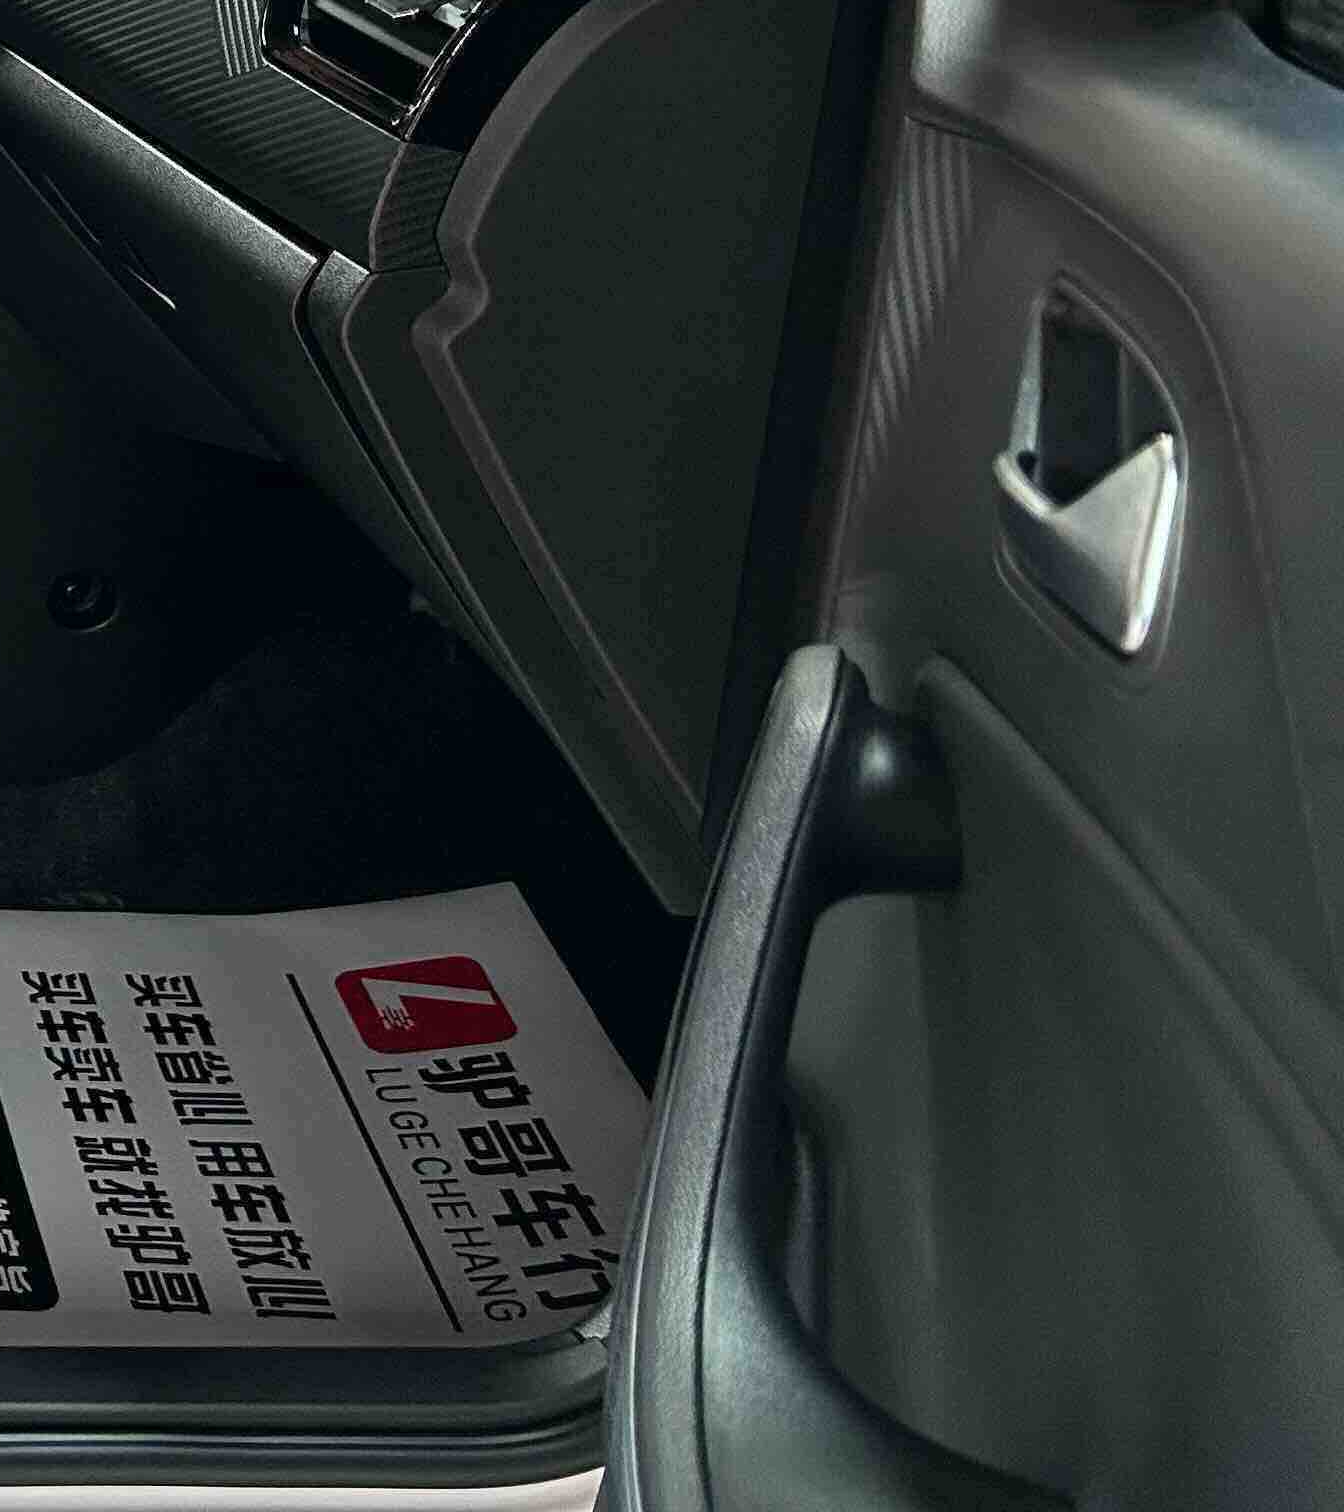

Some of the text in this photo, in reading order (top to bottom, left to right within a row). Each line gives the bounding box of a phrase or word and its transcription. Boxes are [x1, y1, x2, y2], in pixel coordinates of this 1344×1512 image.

[22, 971, 214, 1316] 买车卖车 就找驴哥
[125, 973, 340, 1322] 买车省心 用车放心
[366, 1068, 529, 1322] LU GE CHE HANG
[417, 1050, 621, 1312] 驴哥车行
